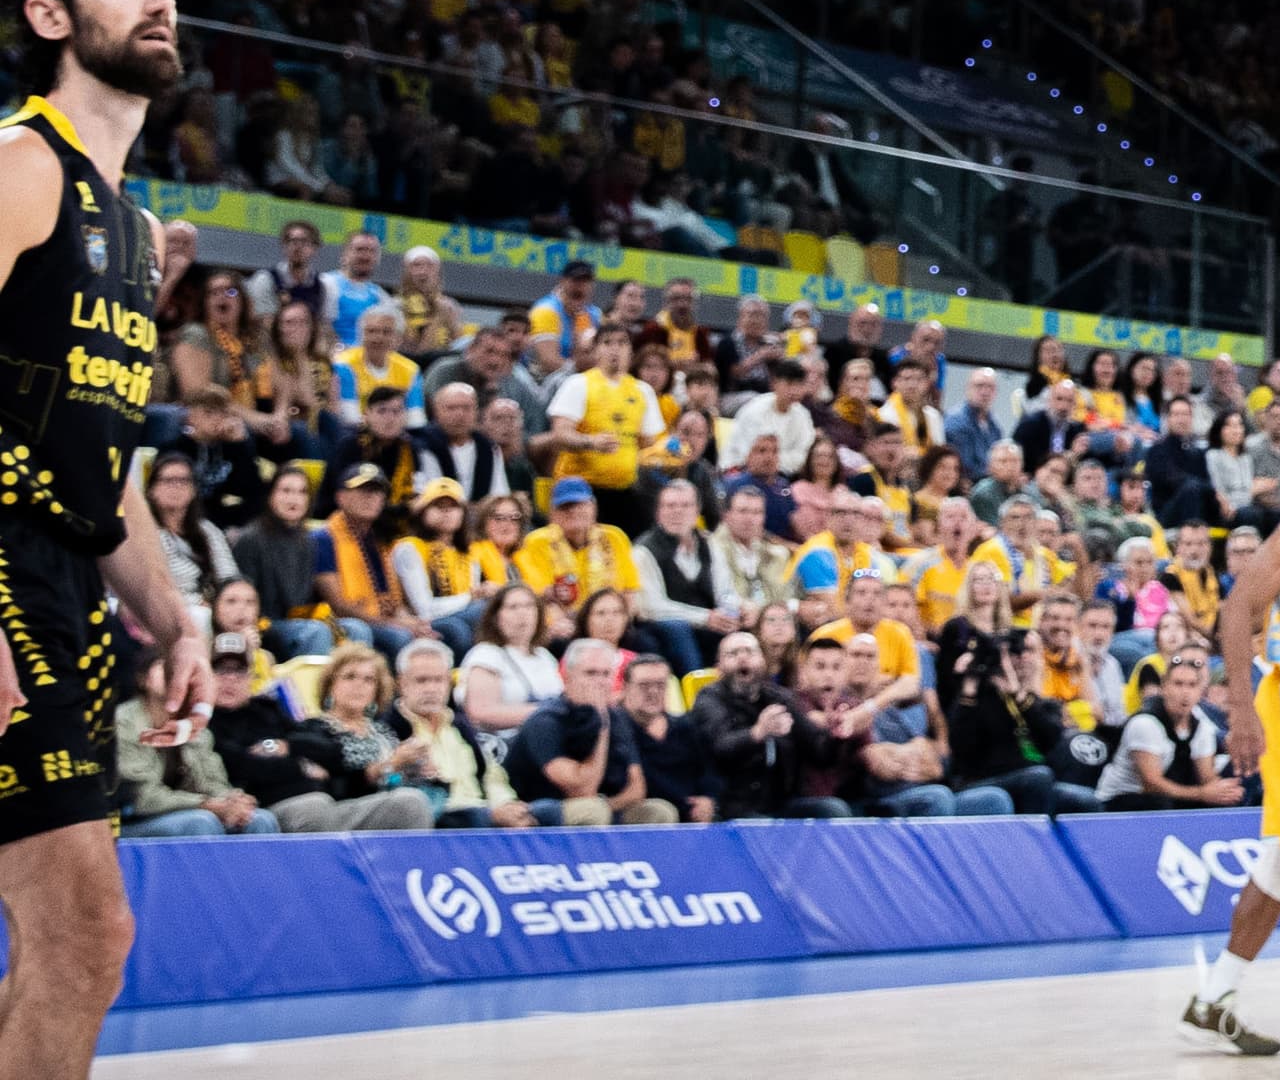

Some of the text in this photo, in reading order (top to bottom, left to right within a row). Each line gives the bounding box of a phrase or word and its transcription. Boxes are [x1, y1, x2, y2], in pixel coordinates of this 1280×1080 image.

[70, 292, 111, 333] LA
[489, 860, 661, 894] GRUPO
[511, 890, 763, 936] solitium
